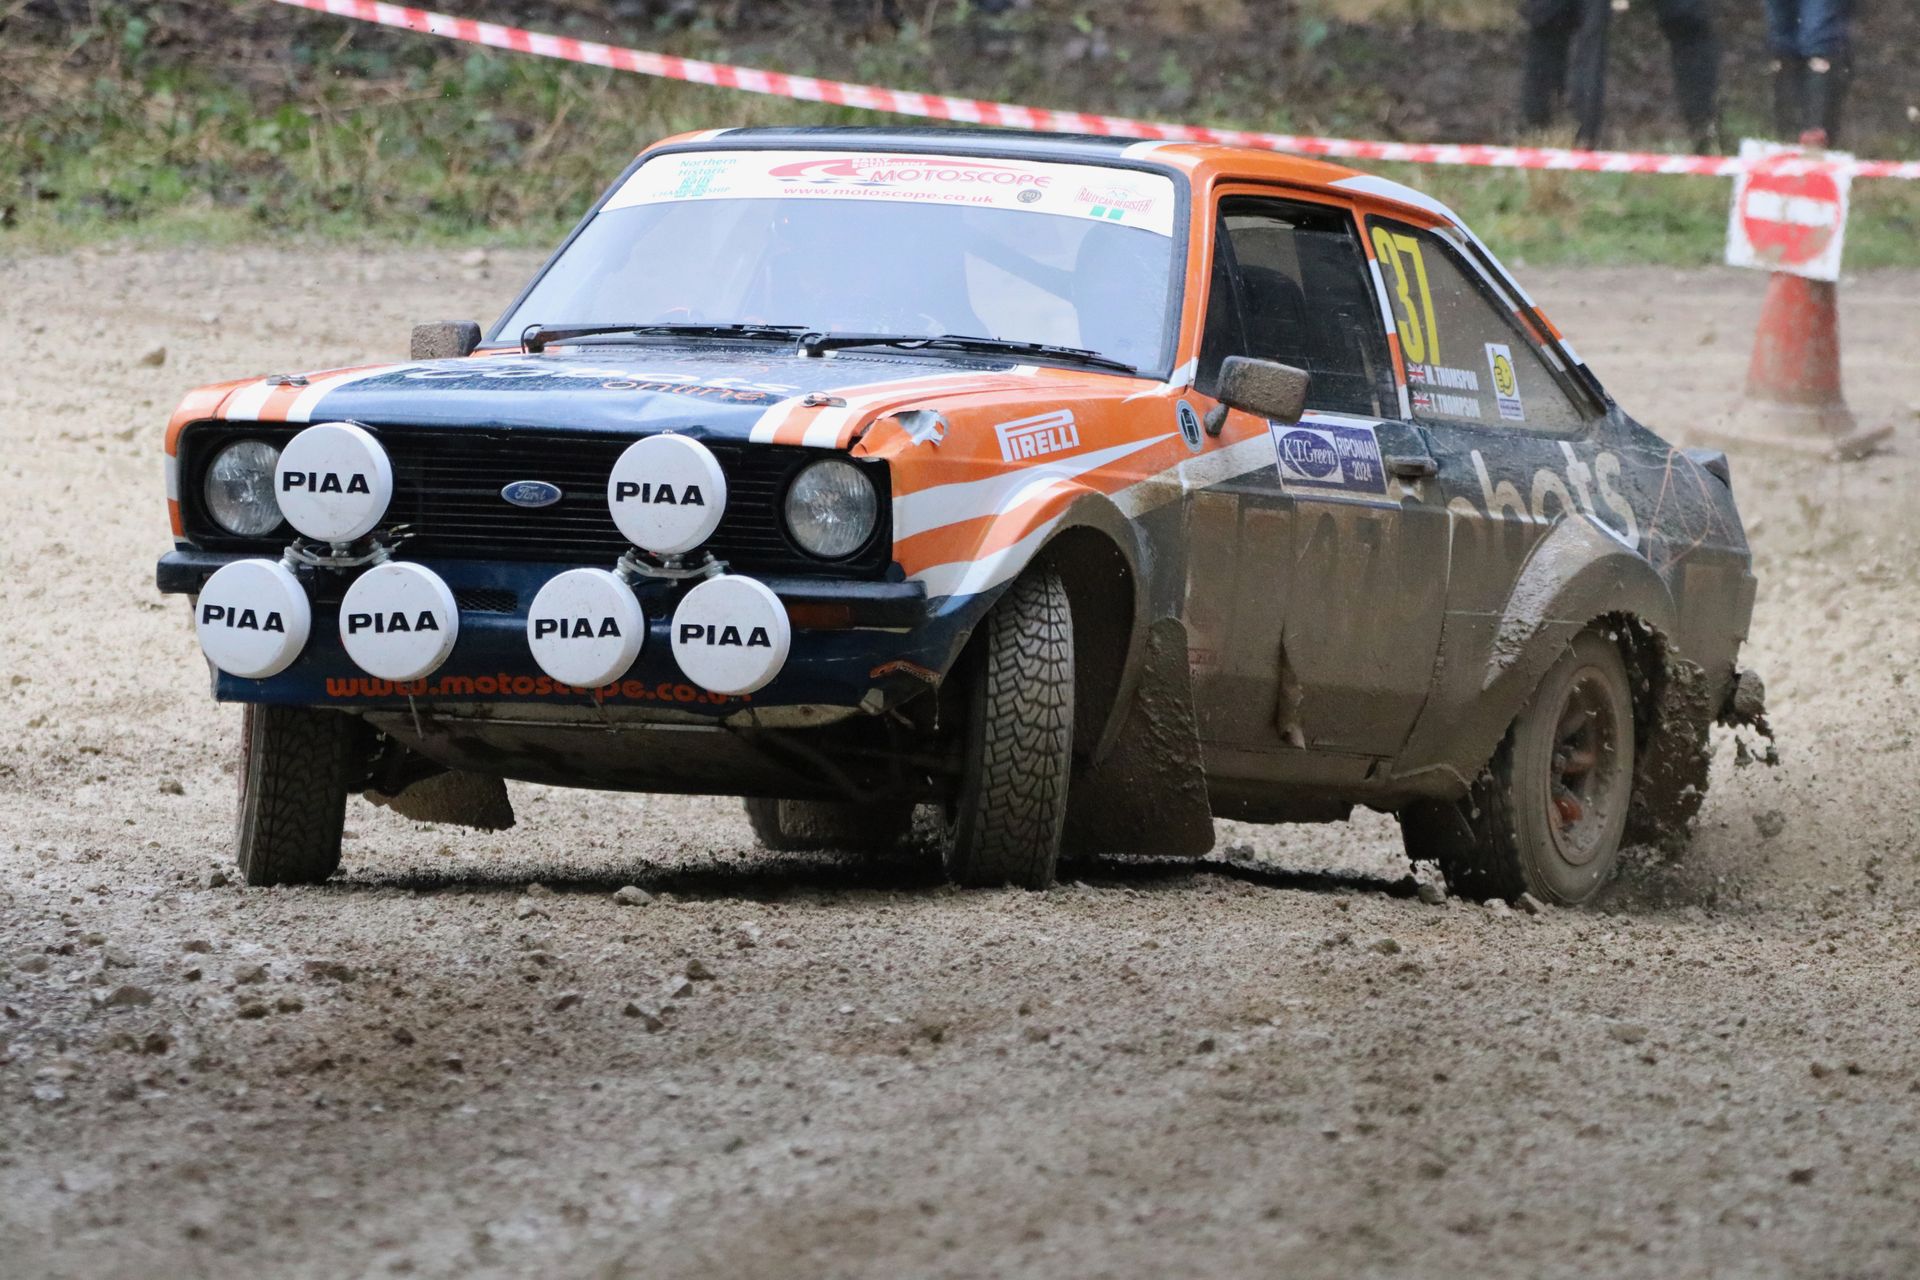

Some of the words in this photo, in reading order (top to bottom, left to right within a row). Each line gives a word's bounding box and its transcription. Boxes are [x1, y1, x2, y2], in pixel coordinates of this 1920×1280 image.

[870, 168, 1054, 188] MOTOSCOPE
[783, 185, 994, 204] www.motoscope.co.uk
[1371, 226, 1441, 367] 37
[601, 379, 767, 401] online
[994, 408, 1081, 463] PIRELLI
[1336, 436, 1379, 462] RIPONIAN
[282, 471, 370, 494] PIAA
[1351, 461, 1374, 483] 2024
[515, 485, 547, 501] Ford
[615, 481, 705, 506] PIAA
[202, 604, 285, 633] PIAA
[348, 610, 439, 634] PIAA
[535, 617, 621, 639] PIAA
[679, 623, 772, 648] PIAA
